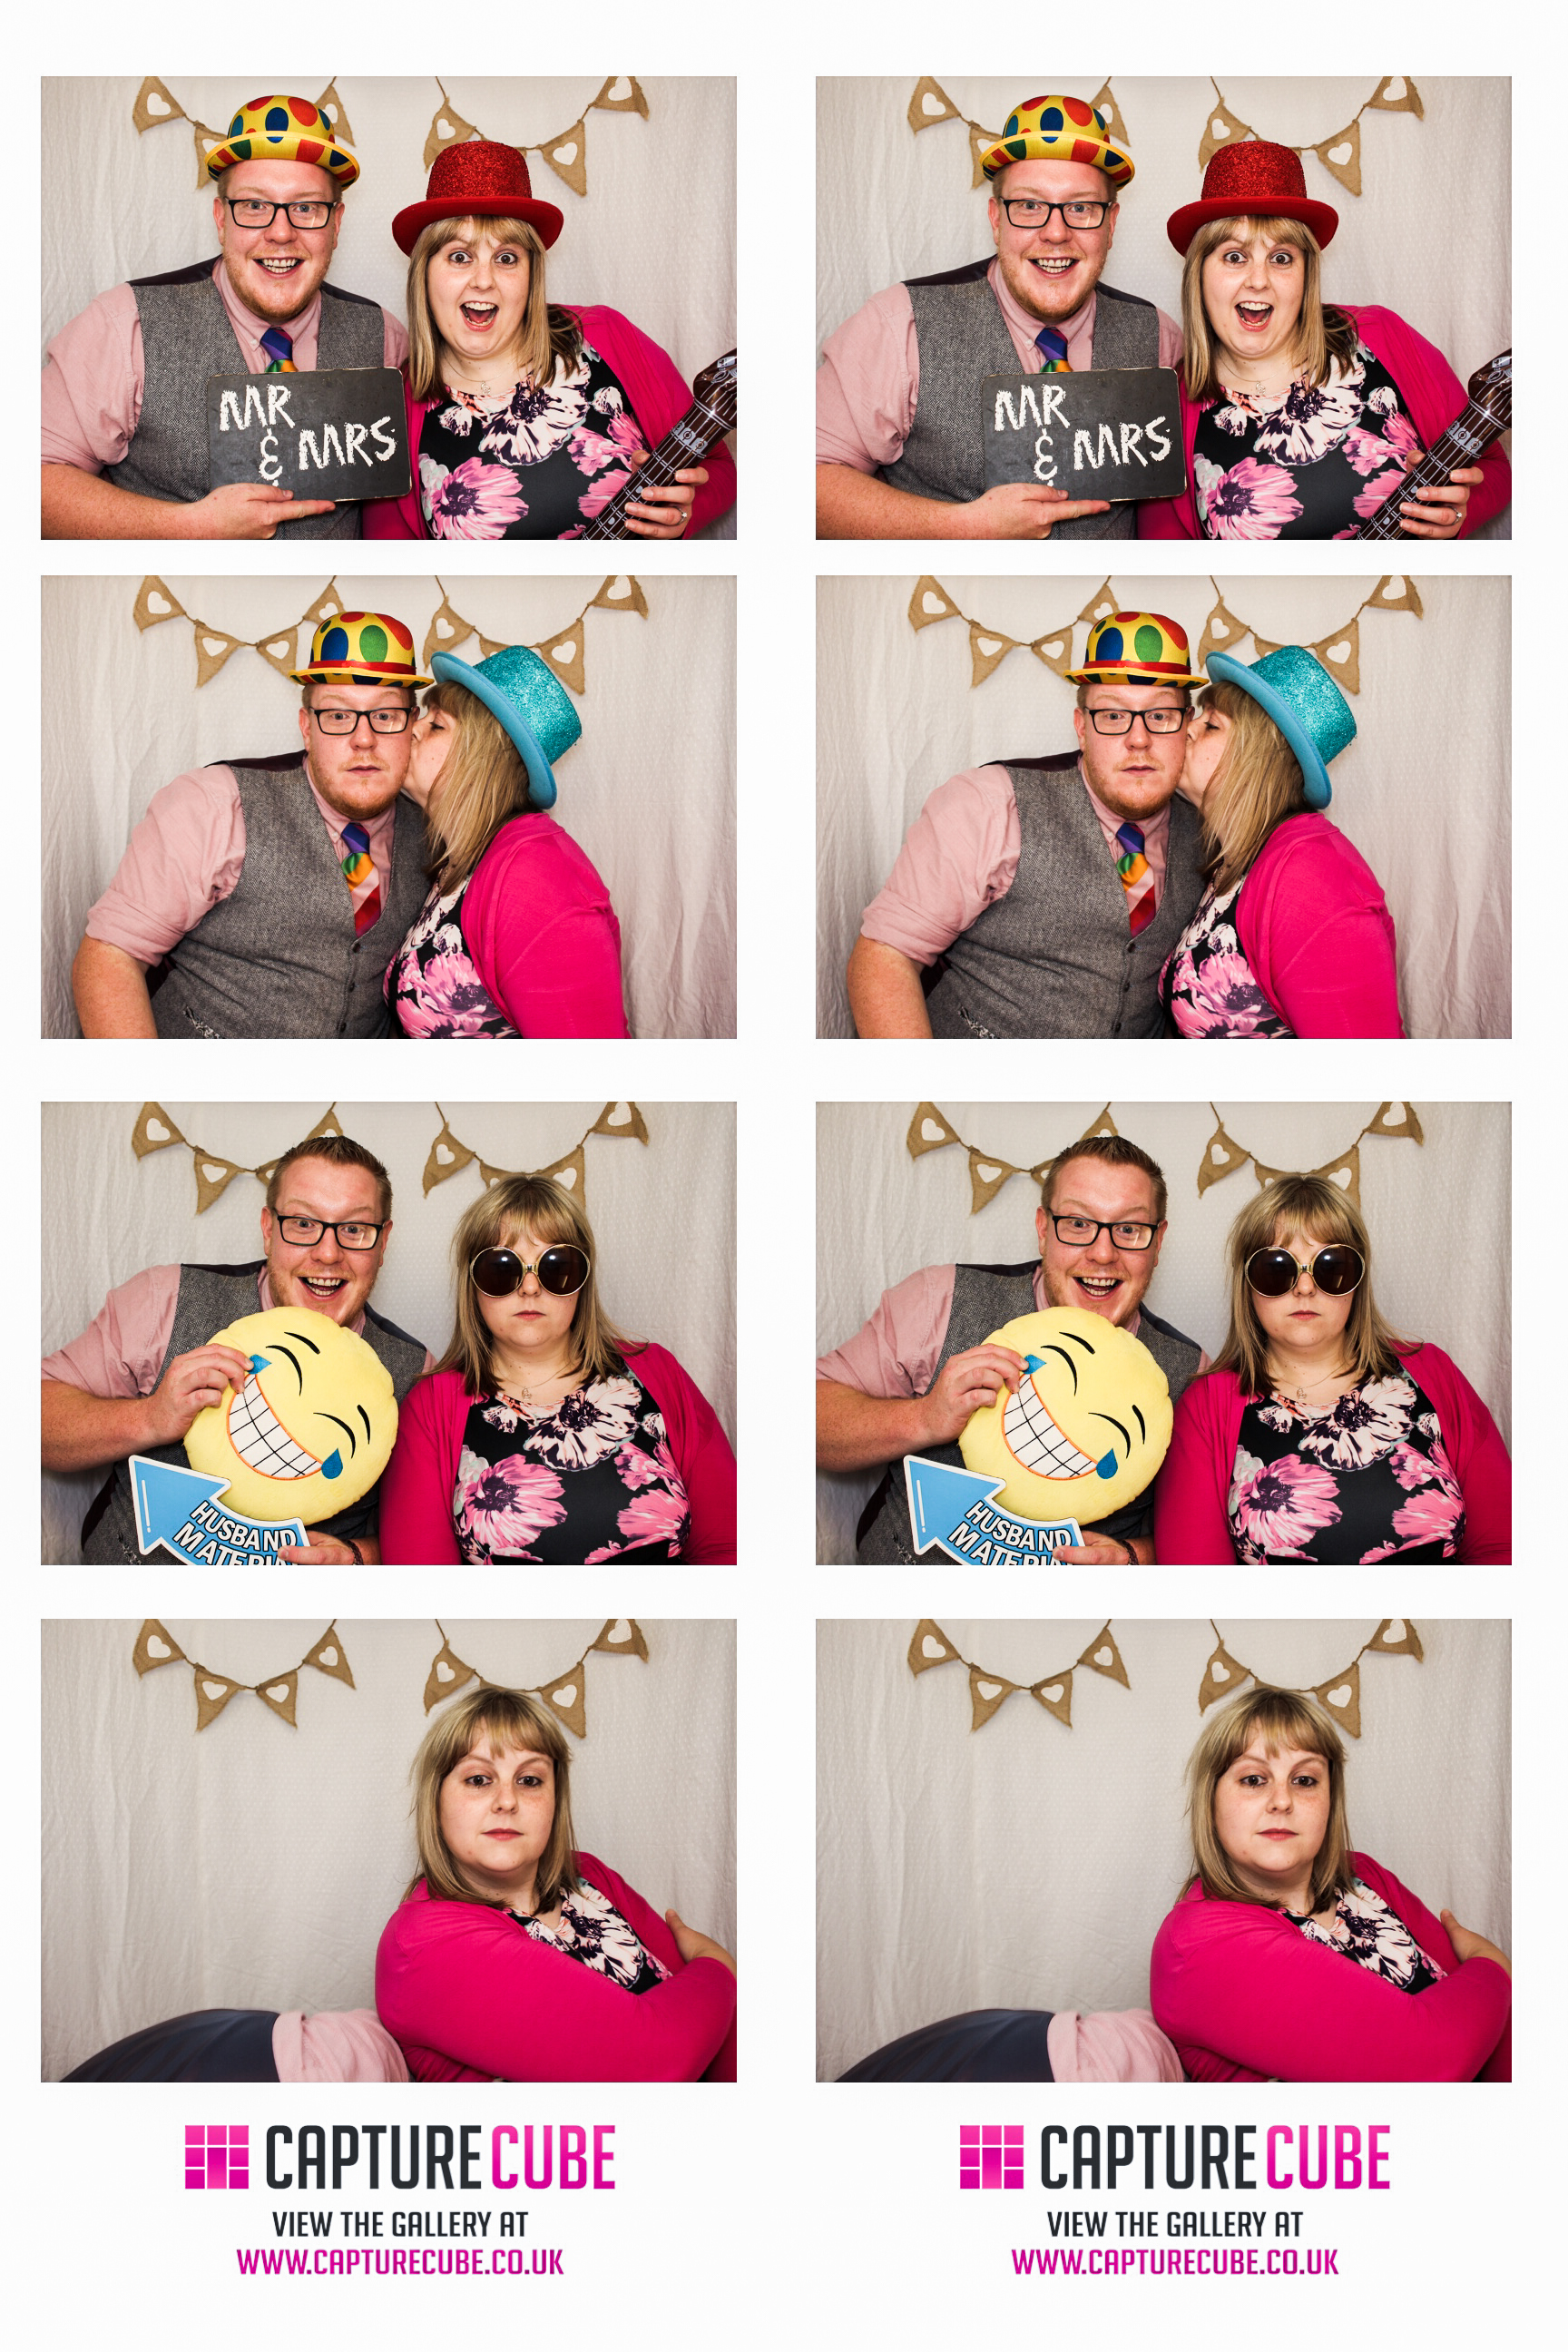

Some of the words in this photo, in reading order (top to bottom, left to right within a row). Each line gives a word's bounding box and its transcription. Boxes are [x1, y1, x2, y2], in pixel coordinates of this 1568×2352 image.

[219, 383, 296, 432] MR
[994, 383, 1071, 432] MR
[258, 427, 283, 488] &
[298, 415, 397, 471] MRS
[1033, 427, 1058, 488] &
[1073, 415, 1172, 471] MRS
[172, 1521, 297, 1566] MATE
[189, 1500, 298, 1553] HUSBAND
[947, 1521, 1072, 1566] MATE
[964, 1500, 1073, 1553] HUSBAND
